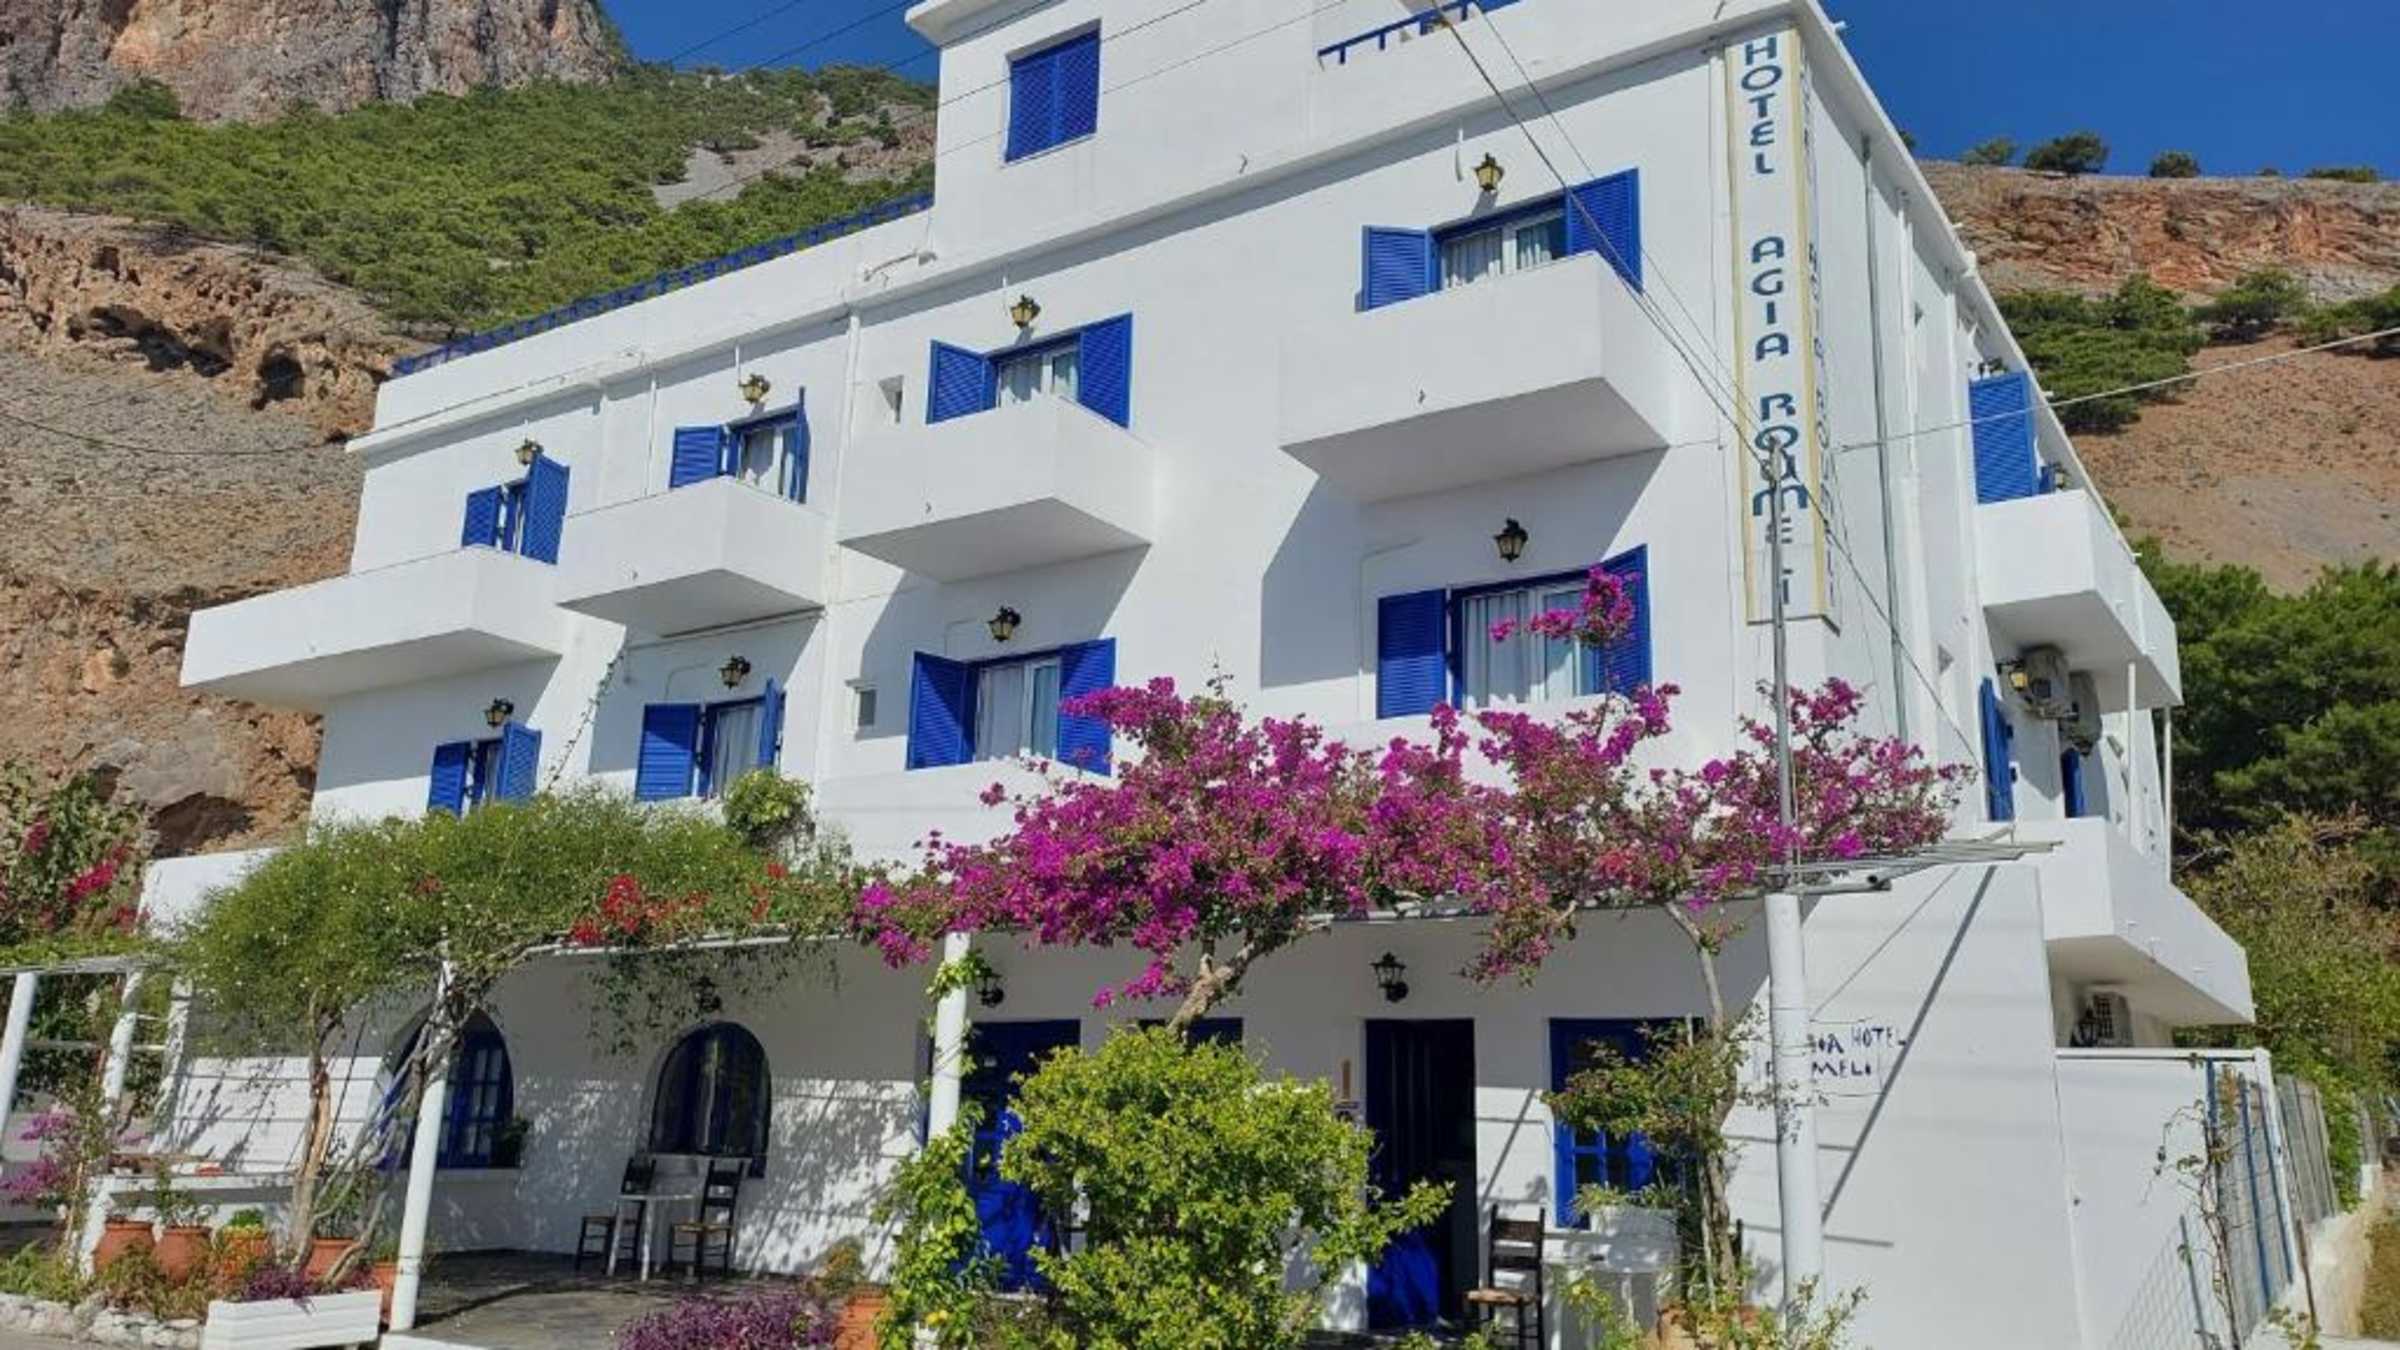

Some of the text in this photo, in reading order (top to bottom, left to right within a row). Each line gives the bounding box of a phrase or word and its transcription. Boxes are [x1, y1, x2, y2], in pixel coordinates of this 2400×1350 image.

[1741, 36, 1808, 605] HOTEL AGIA ROUMEI
